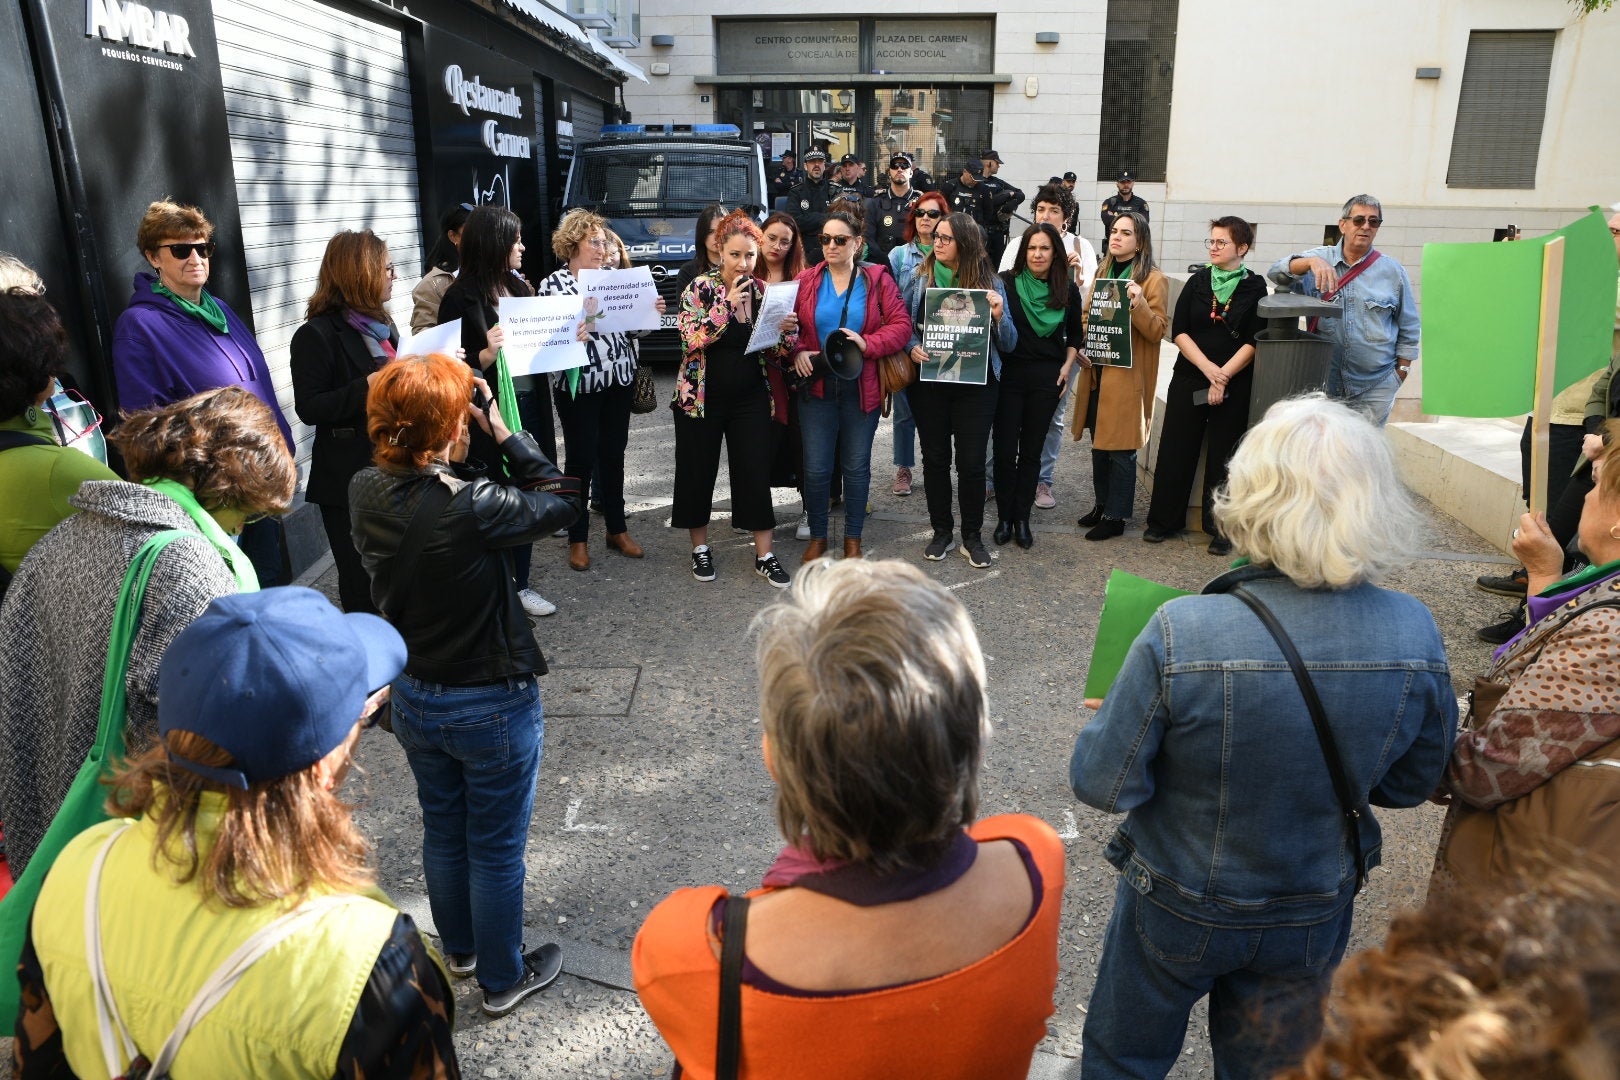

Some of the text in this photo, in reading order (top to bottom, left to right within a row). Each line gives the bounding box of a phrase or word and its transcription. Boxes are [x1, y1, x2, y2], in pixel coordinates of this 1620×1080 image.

[85, 0, 196, 58] AMBAR
[755, 35, 858, 45] CENTRO COMUNITARIO
[876, 35, 968, 44] PLAZA DEL CARMEN
[845, 50, 858, 58] DE
[914, 50, 947, 58] SOCIAL
[101, 47, 184, 71] PEQUEÑOS CERVECEROS
[445, 64, 523, 119] Restaurante
[483, 119, 531, 159] Carmen
[587, 280, 654, 292] La maternidad será
[603, 294, 633, 302] deseada
[618, 303, 633, 311] será
[1113, 301, 1122, 309] LA
[519, 316, 528, 324] les
[529, 315, 554, 323] importa
[548, 327, 559, 335] que
[560, 325, 570, 333] las
[927, 324, 984, 334] AVORTAMENT
[1088, 324, 1123, 335] LES MOLESTA
[956, 333, 960, 341] I
[1087, 333, 1108, 342] QUE LAS
[537, 338, 570, 347] decidamos
[925, 340, 954, 349] SEGUR
[535, 483, 561, 491] Canon
